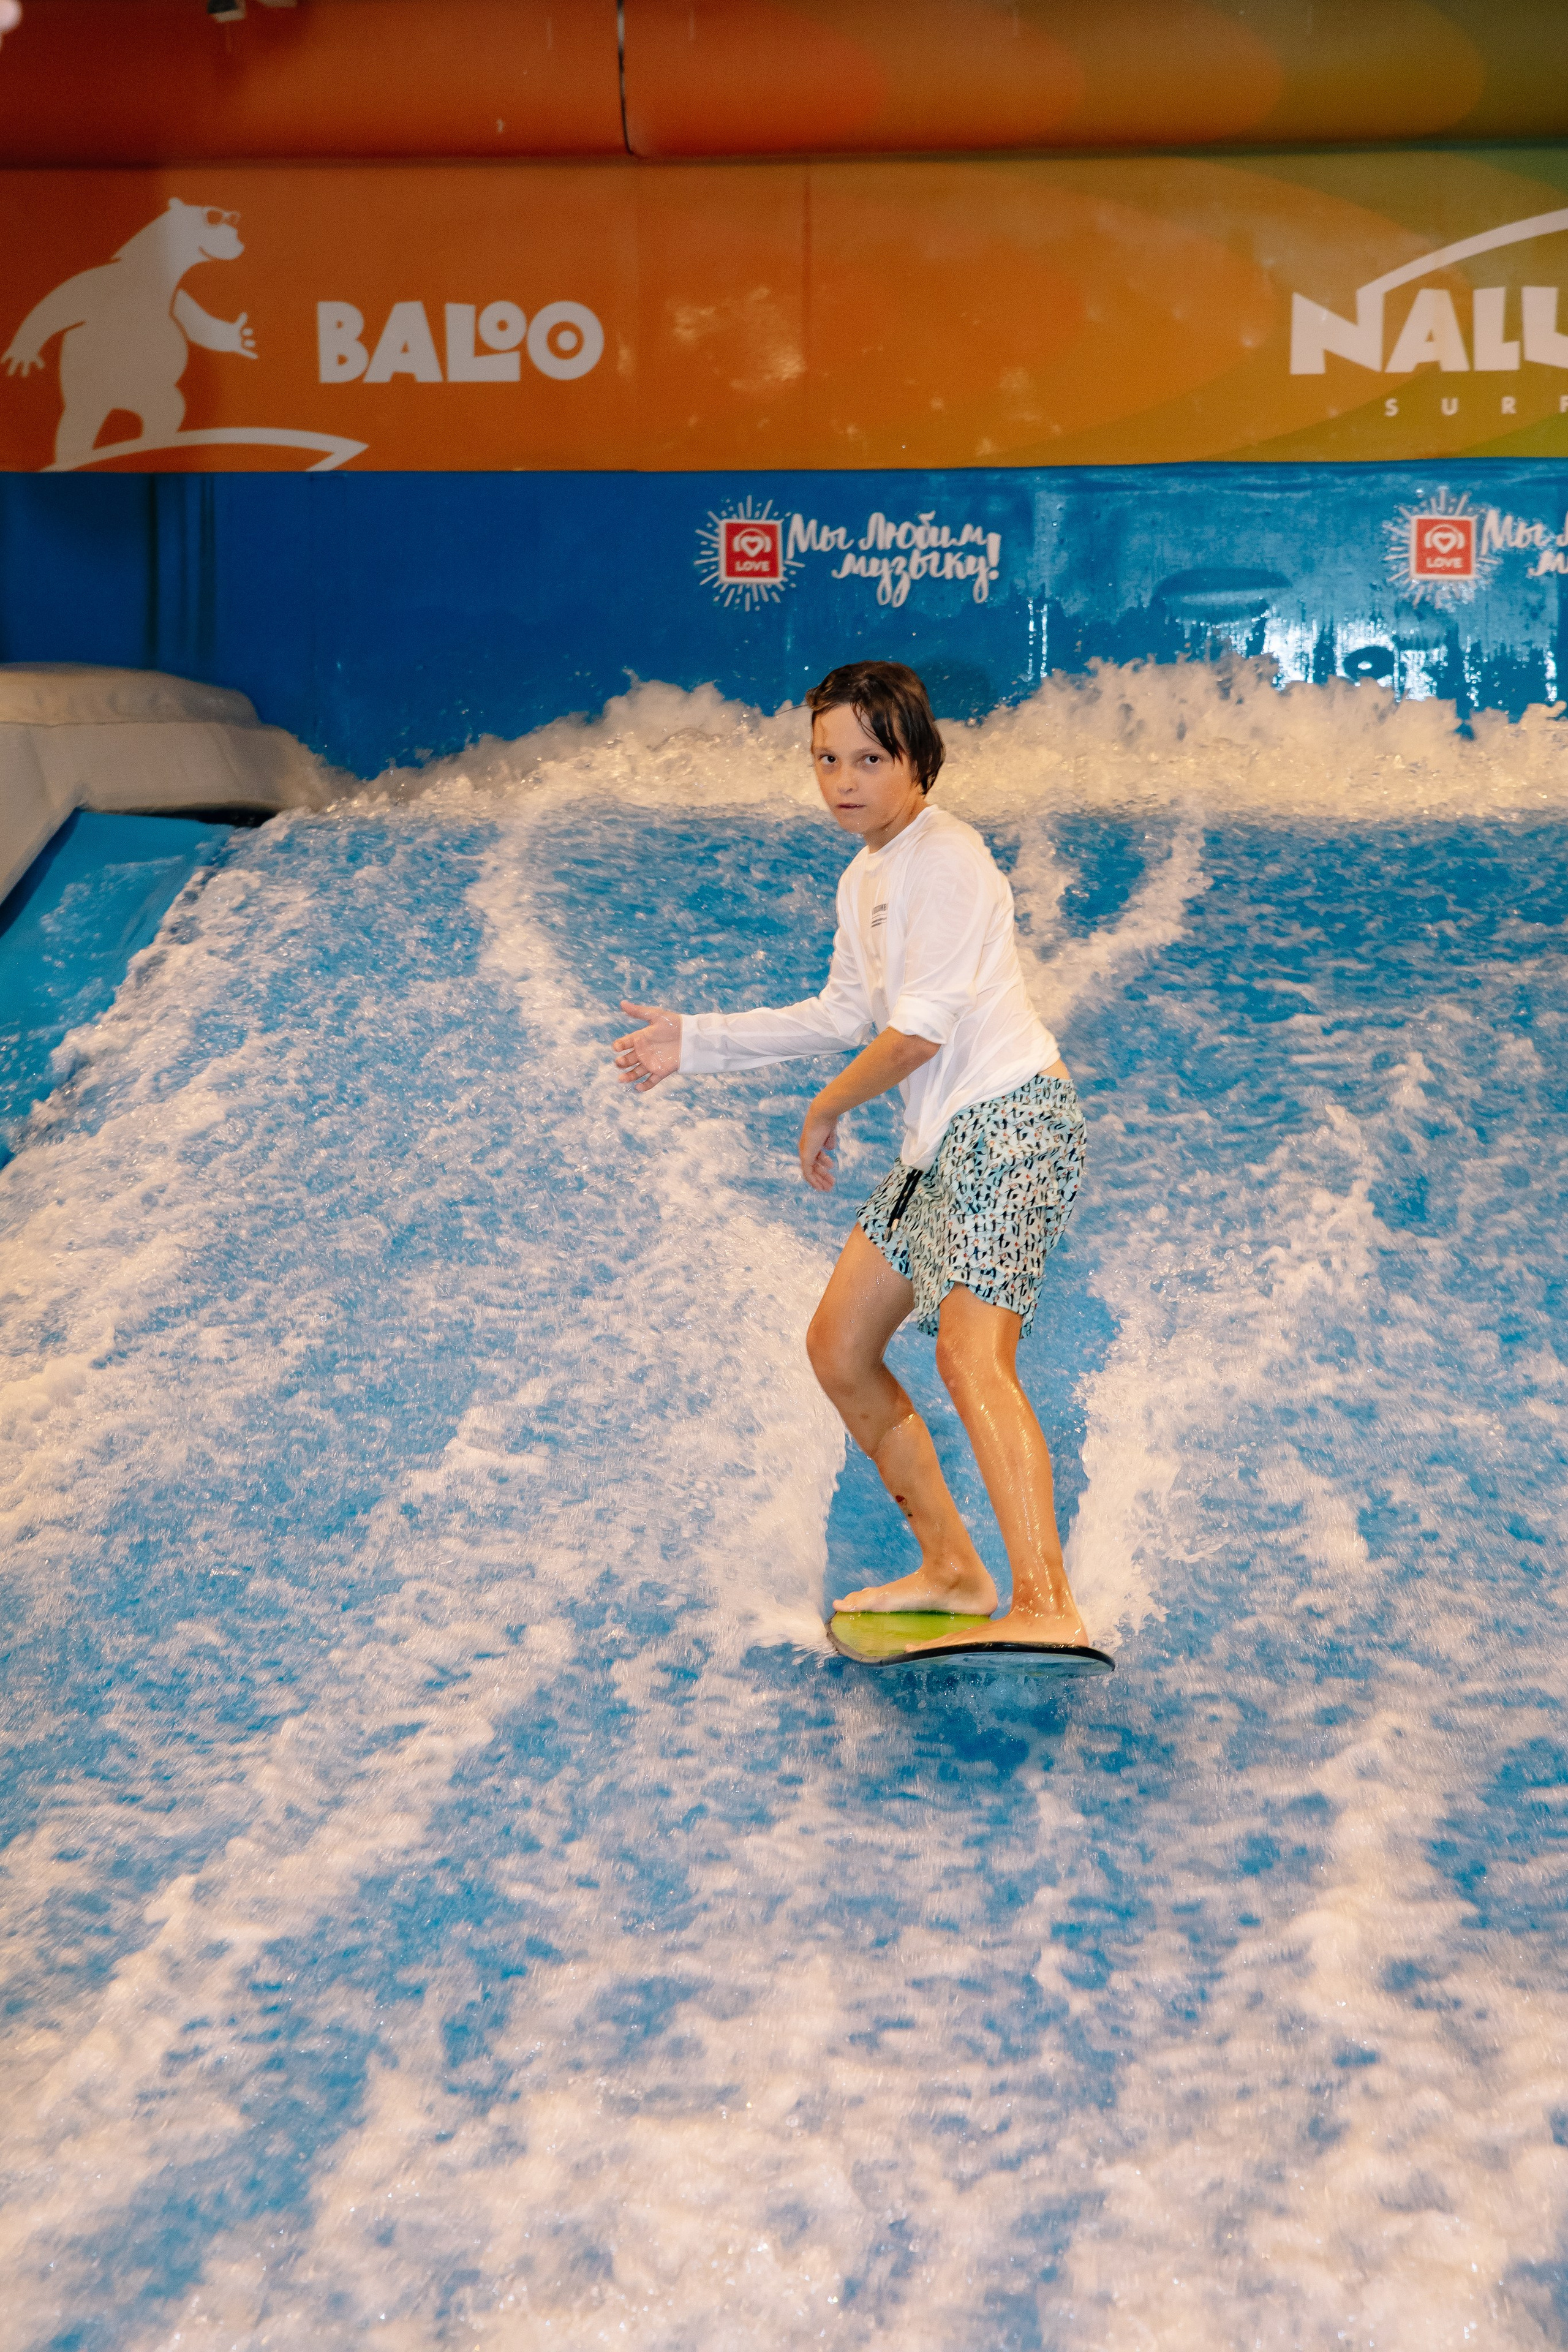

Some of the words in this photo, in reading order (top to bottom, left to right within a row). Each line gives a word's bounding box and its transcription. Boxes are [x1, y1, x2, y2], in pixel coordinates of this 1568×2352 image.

[317, 300, 605, 383] BALOO
[786, 513, 854, 559] Мы
[1481, 509, 1551, 556] Мы
[736, 560, 770, 571] LOVE
[831, 532, 1001, 608] музыку!
[1426, 557, 1463, 568] LOVE
